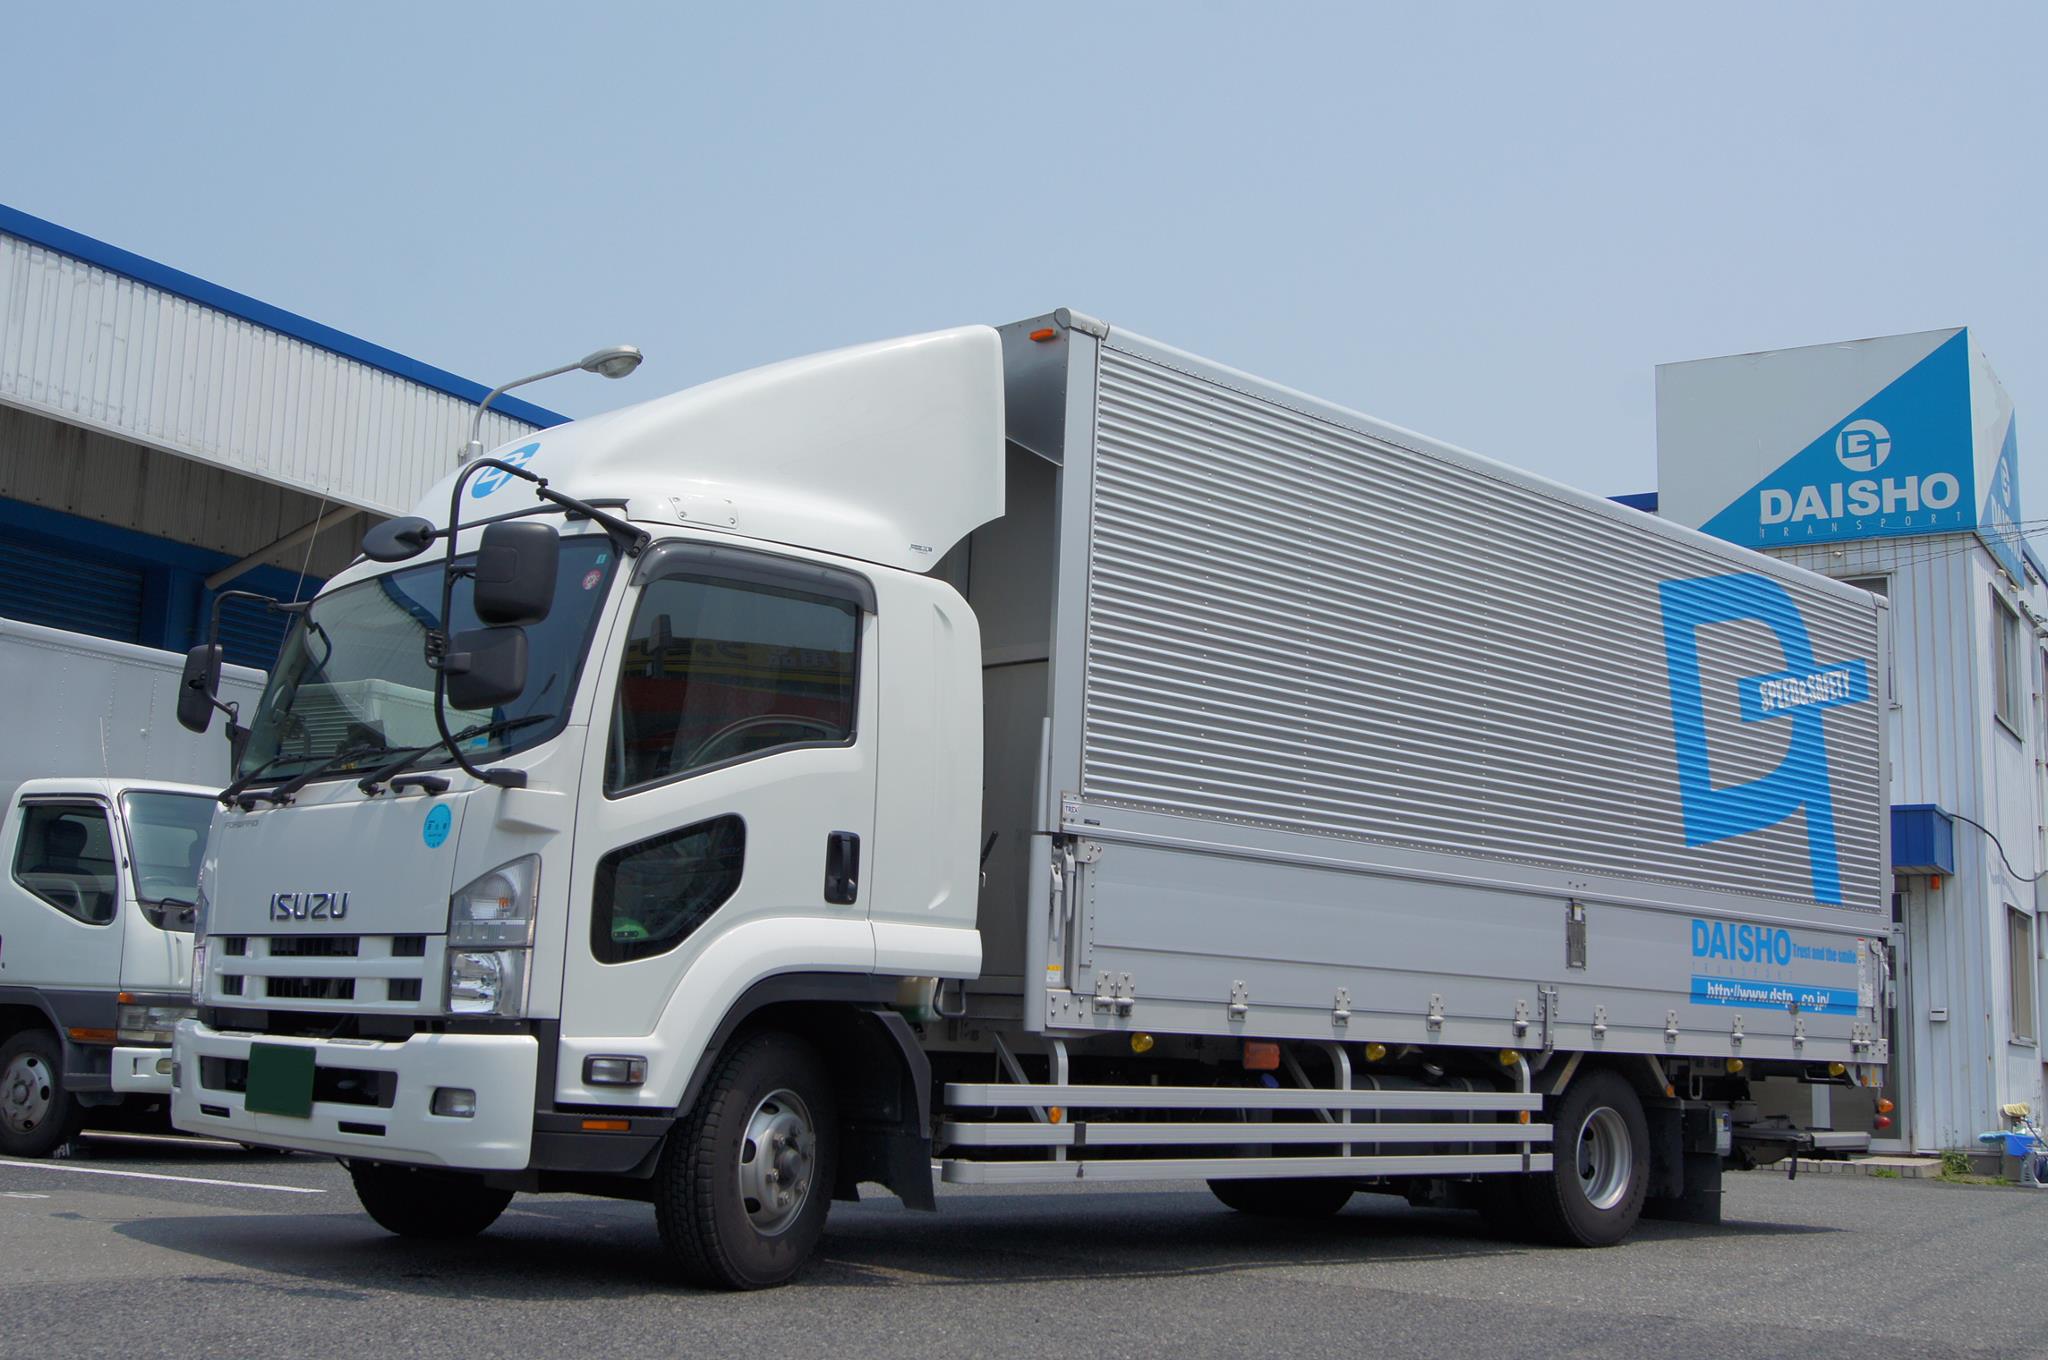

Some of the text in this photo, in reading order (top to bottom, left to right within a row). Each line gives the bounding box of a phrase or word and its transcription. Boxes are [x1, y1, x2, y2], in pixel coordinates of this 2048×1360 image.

[1759, 472, 1960, 525] DAISHO
[1759, 511, 1961, 539] TRANSPORT
[270, 891, 351, 921] ISUZU
[1691, 919, 1793, 966] DAISHO
